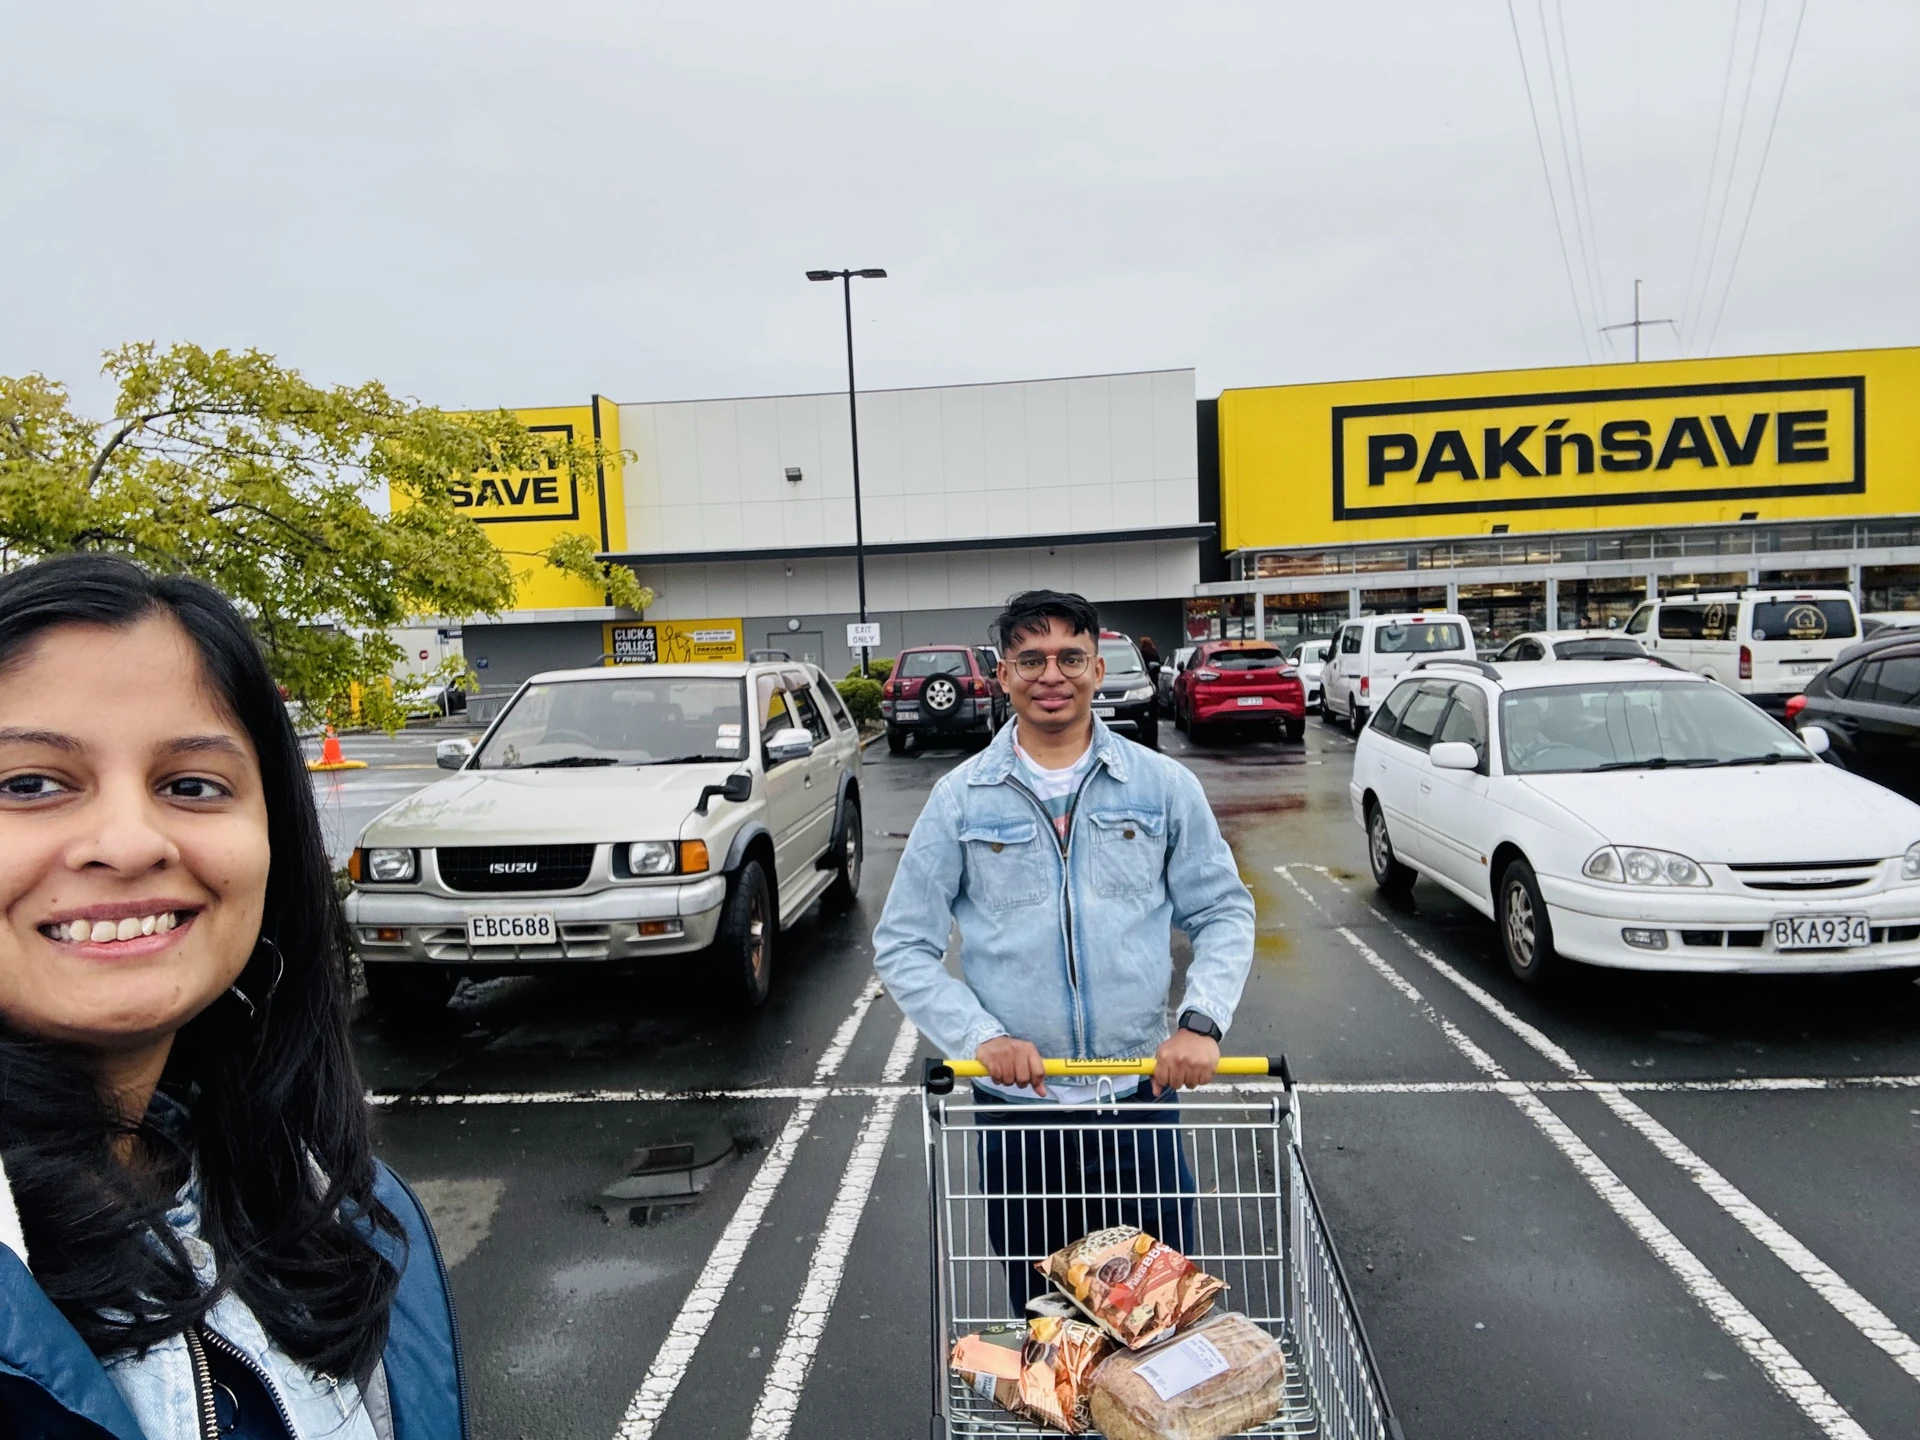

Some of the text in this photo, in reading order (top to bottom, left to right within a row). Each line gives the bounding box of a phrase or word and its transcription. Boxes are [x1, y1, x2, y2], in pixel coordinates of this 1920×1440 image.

[447, 476, 559, 507] SAVE
[615, 627, 655, 640] CLICK &
[852, 636, 875, 644] ONLY
[615, 639, 655, 653] COLLECT
[489, 862, 538, 874] ISUZU
[472, 918, 550, 937] EBC688
[1775, 920, 1866, 944] BKA934
